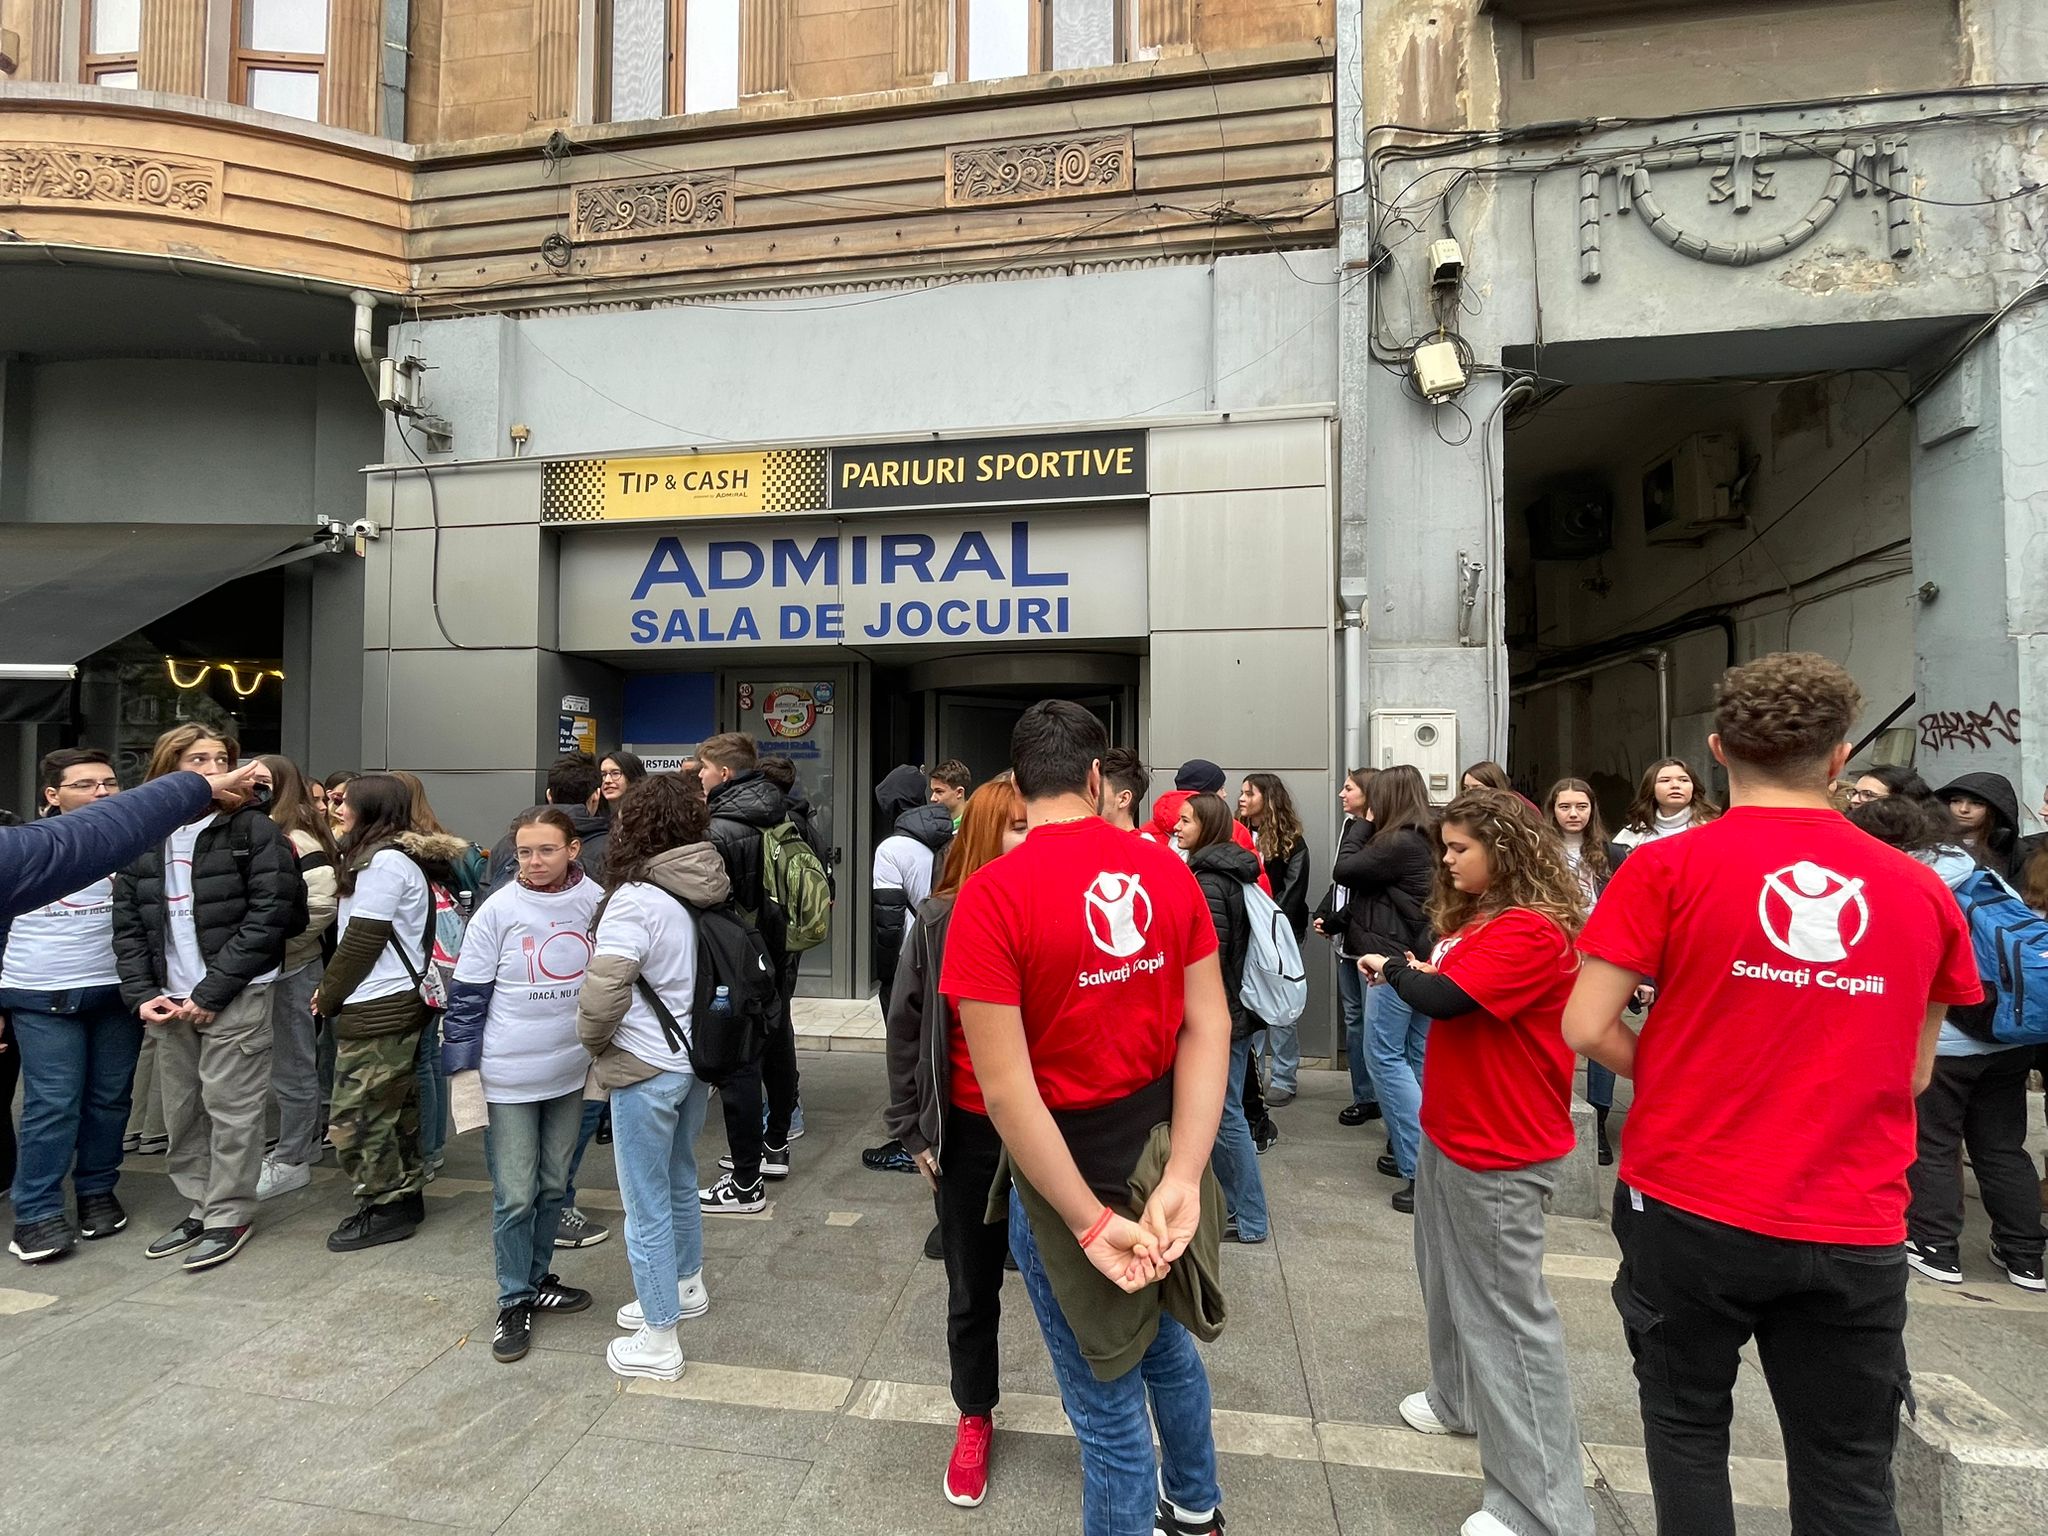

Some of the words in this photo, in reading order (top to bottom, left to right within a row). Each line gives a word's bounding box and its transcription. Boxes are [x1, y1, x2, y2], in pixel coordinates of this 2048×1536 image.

[841, 456, 965, 489] PARIURI
[975, 446, 1134, 482] SPORTIVE
[618, 472, 658, 495] TIP
[665, 474, 677, 490] &
[683, 469, 749, 491] CASH
[630, 521, 1070, 601] ADMIRAL
[630, 606, 761, 644] SALA
[778, 604, 845, 640] DE
[864, 596, 1070, 638] JOCURI
[641, 759, 684, 769] IRSTBAN
[560, 990, 571, 999] NU
[1816, 970, 1884, 996] Copiii
